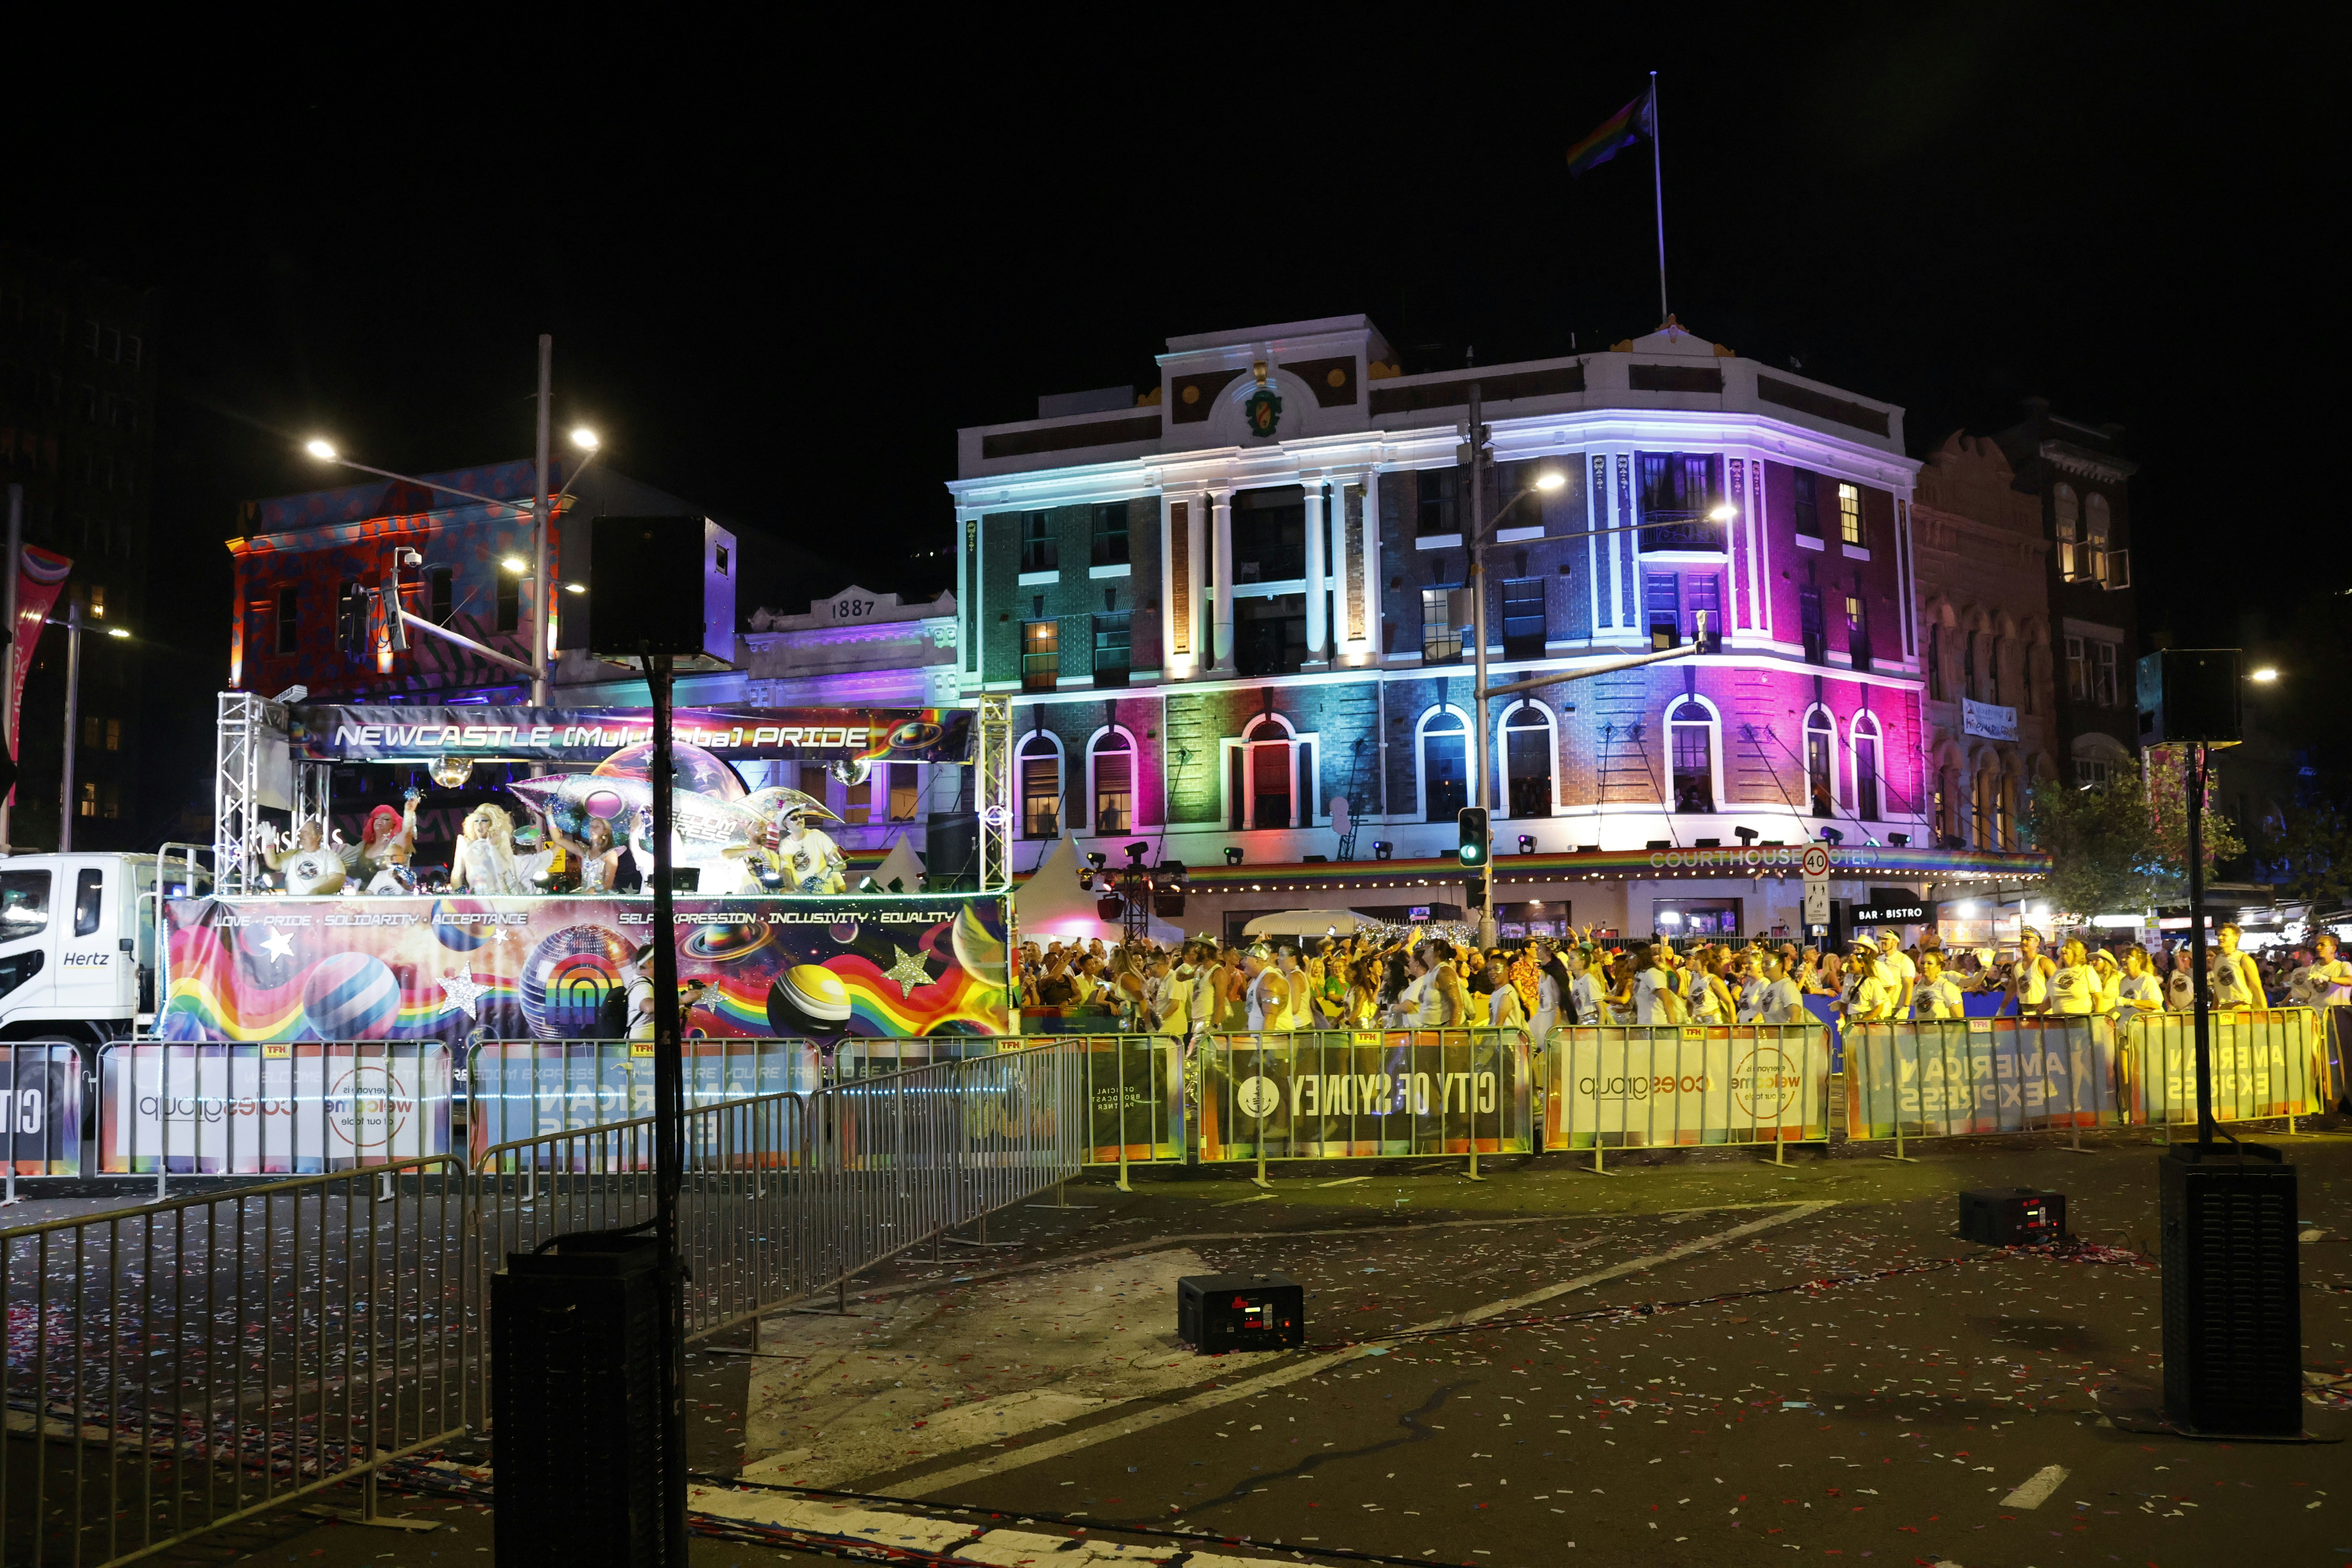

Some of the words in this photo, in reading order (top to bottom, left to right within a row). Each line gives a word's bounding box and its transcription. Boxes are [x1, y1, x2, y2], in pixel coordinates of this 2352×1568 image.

[833, 599, 874, 619] 1887
[334, 726, 554, 748] NEWCASTLE
[753, 727, 870, 748] PRIDE
[1650, 848, 1802, 868] COURTHOUSE
[1827, 849, 1868, 866] OTEL
[1807, 855, 1824, 867] 40
[215, 916, 250, 927] LOVE
[263, 915, 311, 926] PRIDE
[324, 914, 421, 926] SOLIDARITY
[431, 913, 527, 925] ACCEPTANCE
[672, 912, 756, 924] XPRESSION
[769, 912, 869, 924] INCLUSIVITY
[880, 911, 956, 924] EQUALITY
[1858, 911, 1878, 920] BAR
[1886, 908, 1923, 919] BISTRO
[64, 953, 110, 965] Hertz
